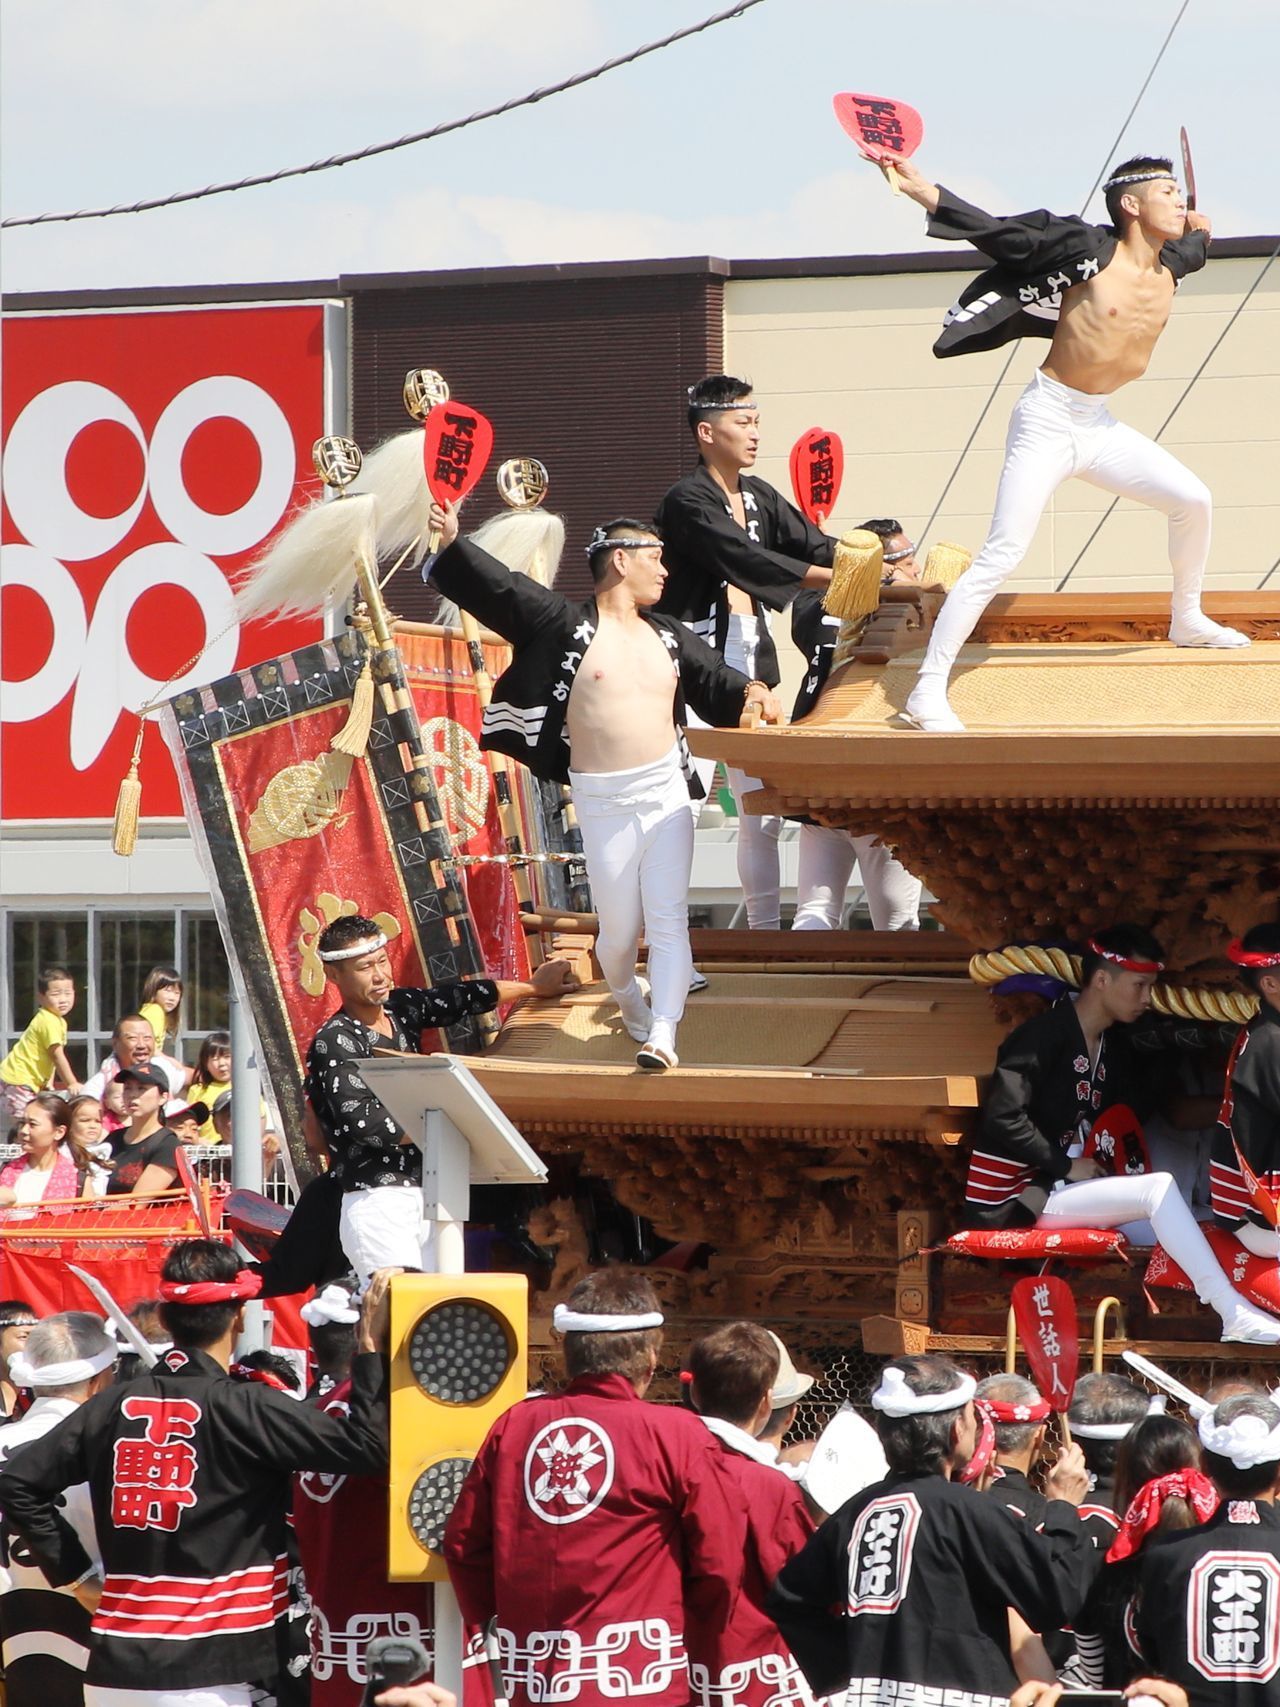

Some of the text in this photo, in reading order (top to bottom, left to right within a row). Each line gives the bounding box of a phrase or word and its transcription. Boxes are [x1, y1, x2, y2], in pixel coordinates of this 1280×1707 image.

[852, 97, 905, 151] 下野町
[434, 412, 478, 491] 下野町
[809, 436, 834, 507] 下野町
[1032, 1283, 1069, 1396] 世話人
[111, 1396, 203, 1533] 下野町
[862, 1511, 900, 1598] 大工町
[1211, 1569, 1263, 1663] 大工町
